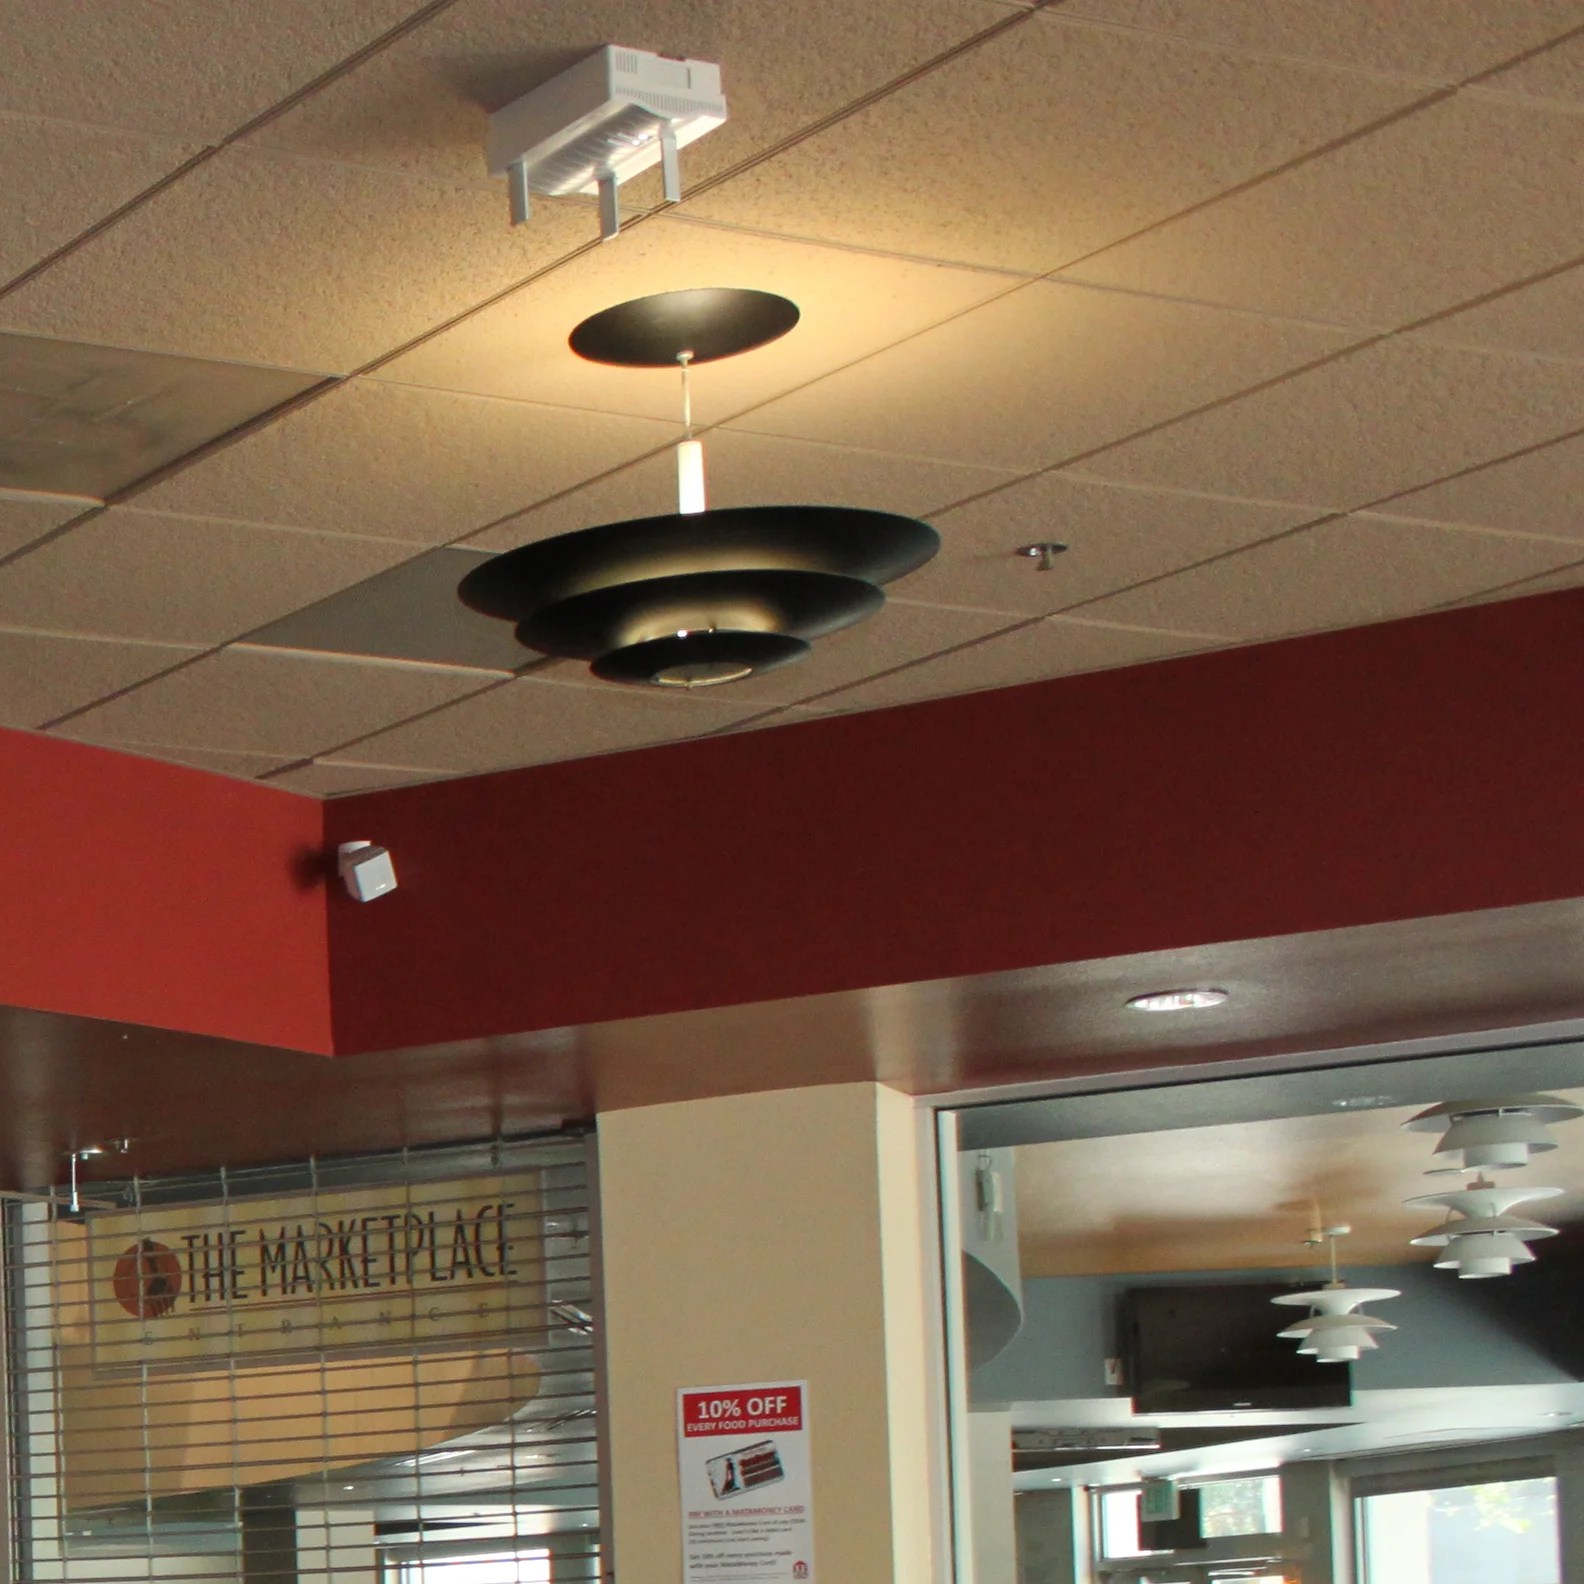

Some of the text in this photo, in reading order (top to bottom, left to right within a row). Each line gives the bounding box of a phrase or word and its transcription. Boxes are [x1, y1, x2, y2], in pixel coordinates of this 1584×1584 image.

[181, 1203, 518, 1303] THE MARKETPLACE
[698, 1396, 787, 1418] 10% OFF
[687, 1416, 799, 1432] EVERY FOOD PURCHASE
